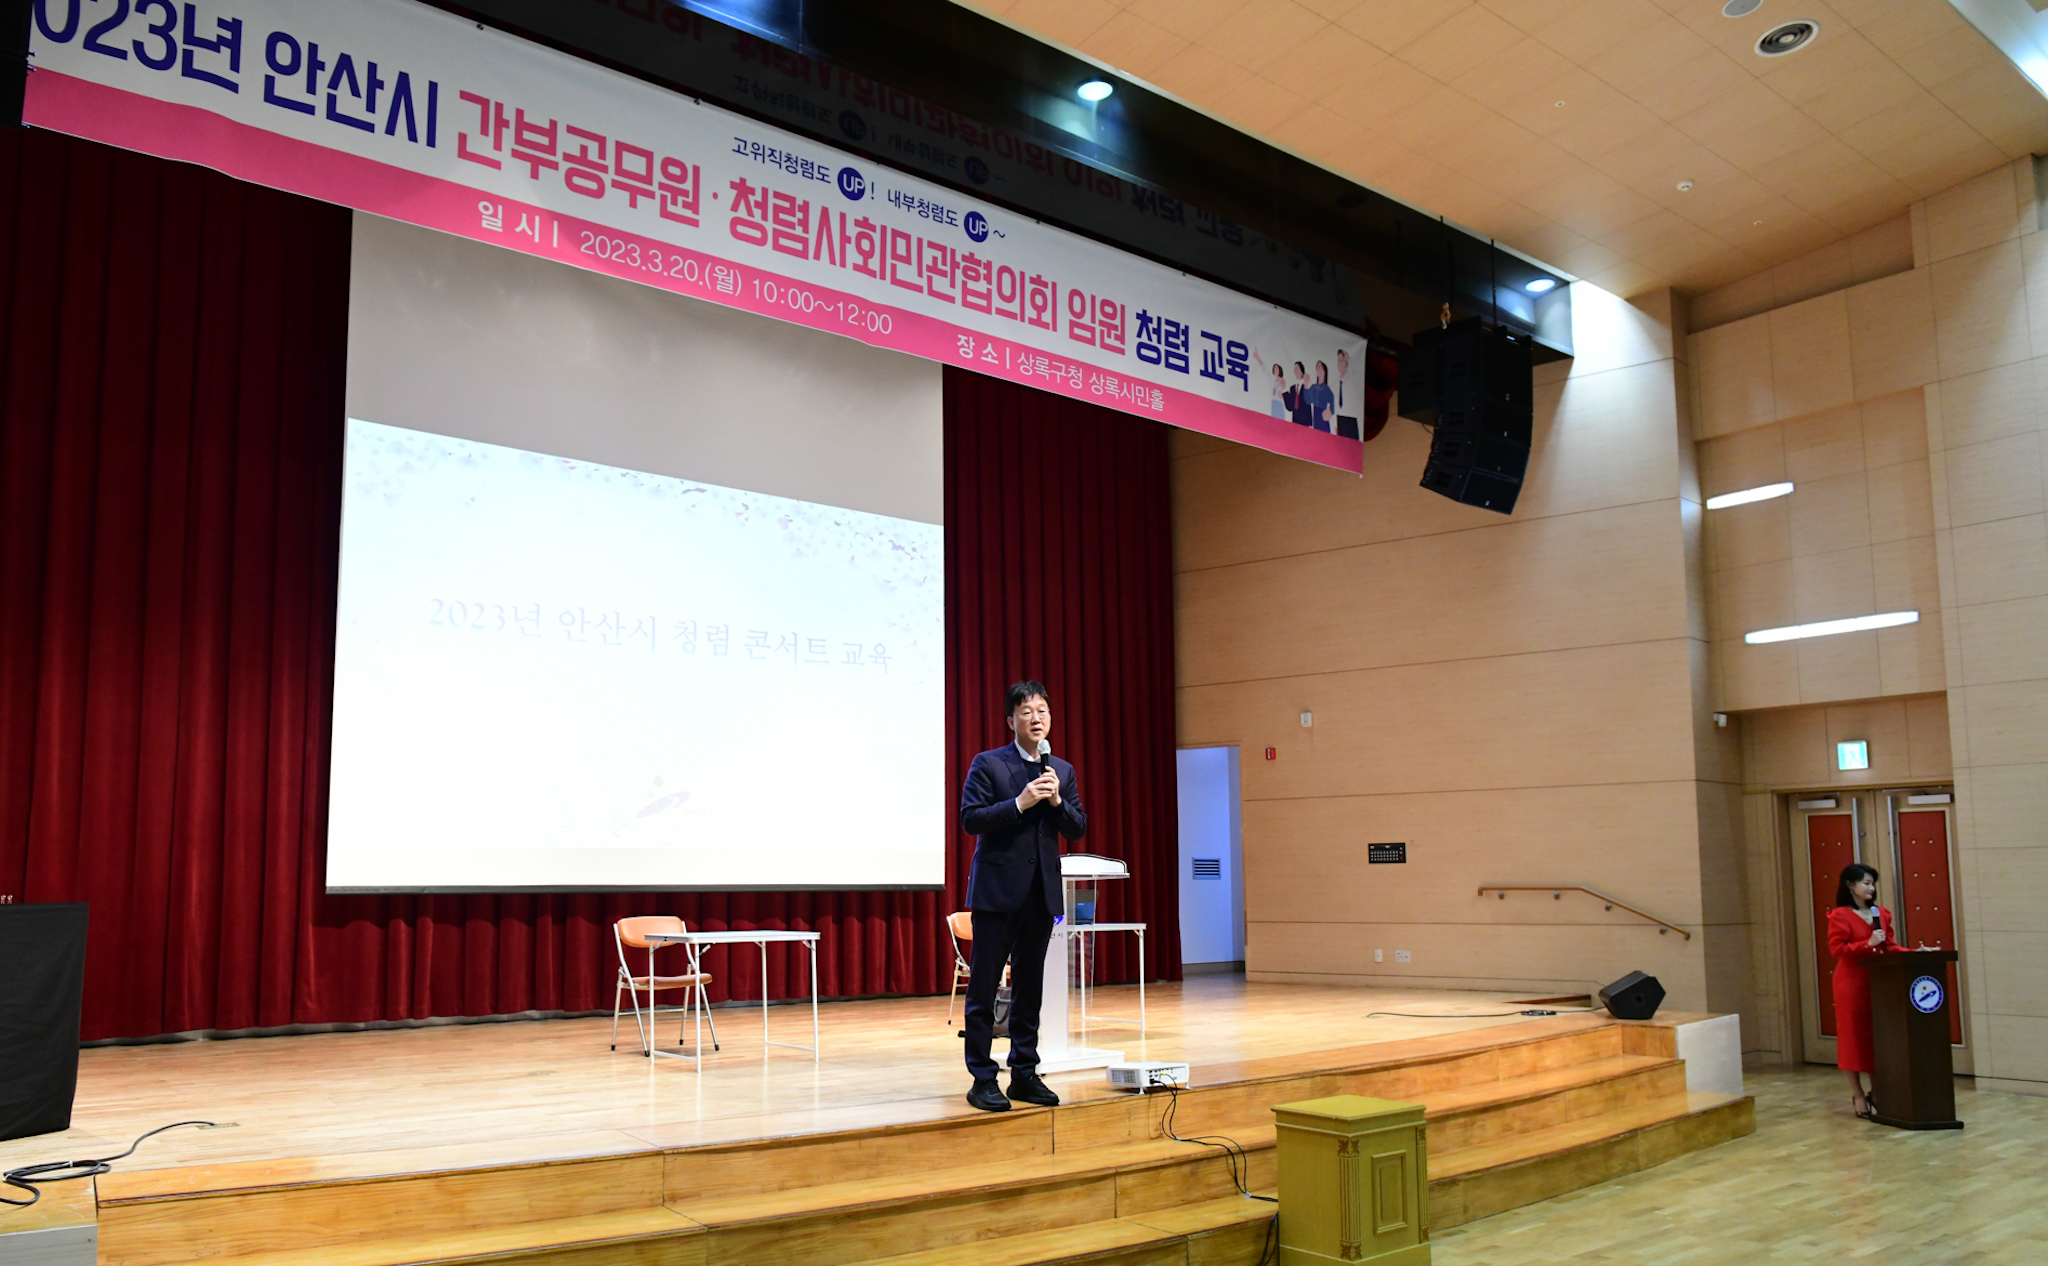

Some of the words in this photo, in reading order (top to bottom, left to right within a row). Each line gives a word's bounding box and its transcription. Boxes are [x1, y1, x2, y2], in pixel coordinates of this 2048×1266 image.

[263, 31, 438, 149] 안산시
[456, 89, 700, 229] 간부공무원
[729, 176, 1058, 333] 청렴사회민관협의회
[1068, 288, 1126, 356] 임원
[1135, 309, 1190, 375] 청렴
[1199, 330, 1250, 392] 교육
[731, 136, 831, 184] 고위직청렴도
[887, 188, 959, 227] 내부청렴도
[579, 230, 742, 298] 2023.3.20.(월)
[752, 277, 893, 335] 10:00~12:00
[1017, 351, 1083, 389] 상록구청
[1089, 371, 1165, 412] 상록시민홀
[427, 597, 544, 640] 2023년
[557, 605, 658, 653] 안산시
[671, 618, 731, 658] 청렴
[743, 627, 831, 666] 콘서트
[840, 641, 894, 676] 교육
